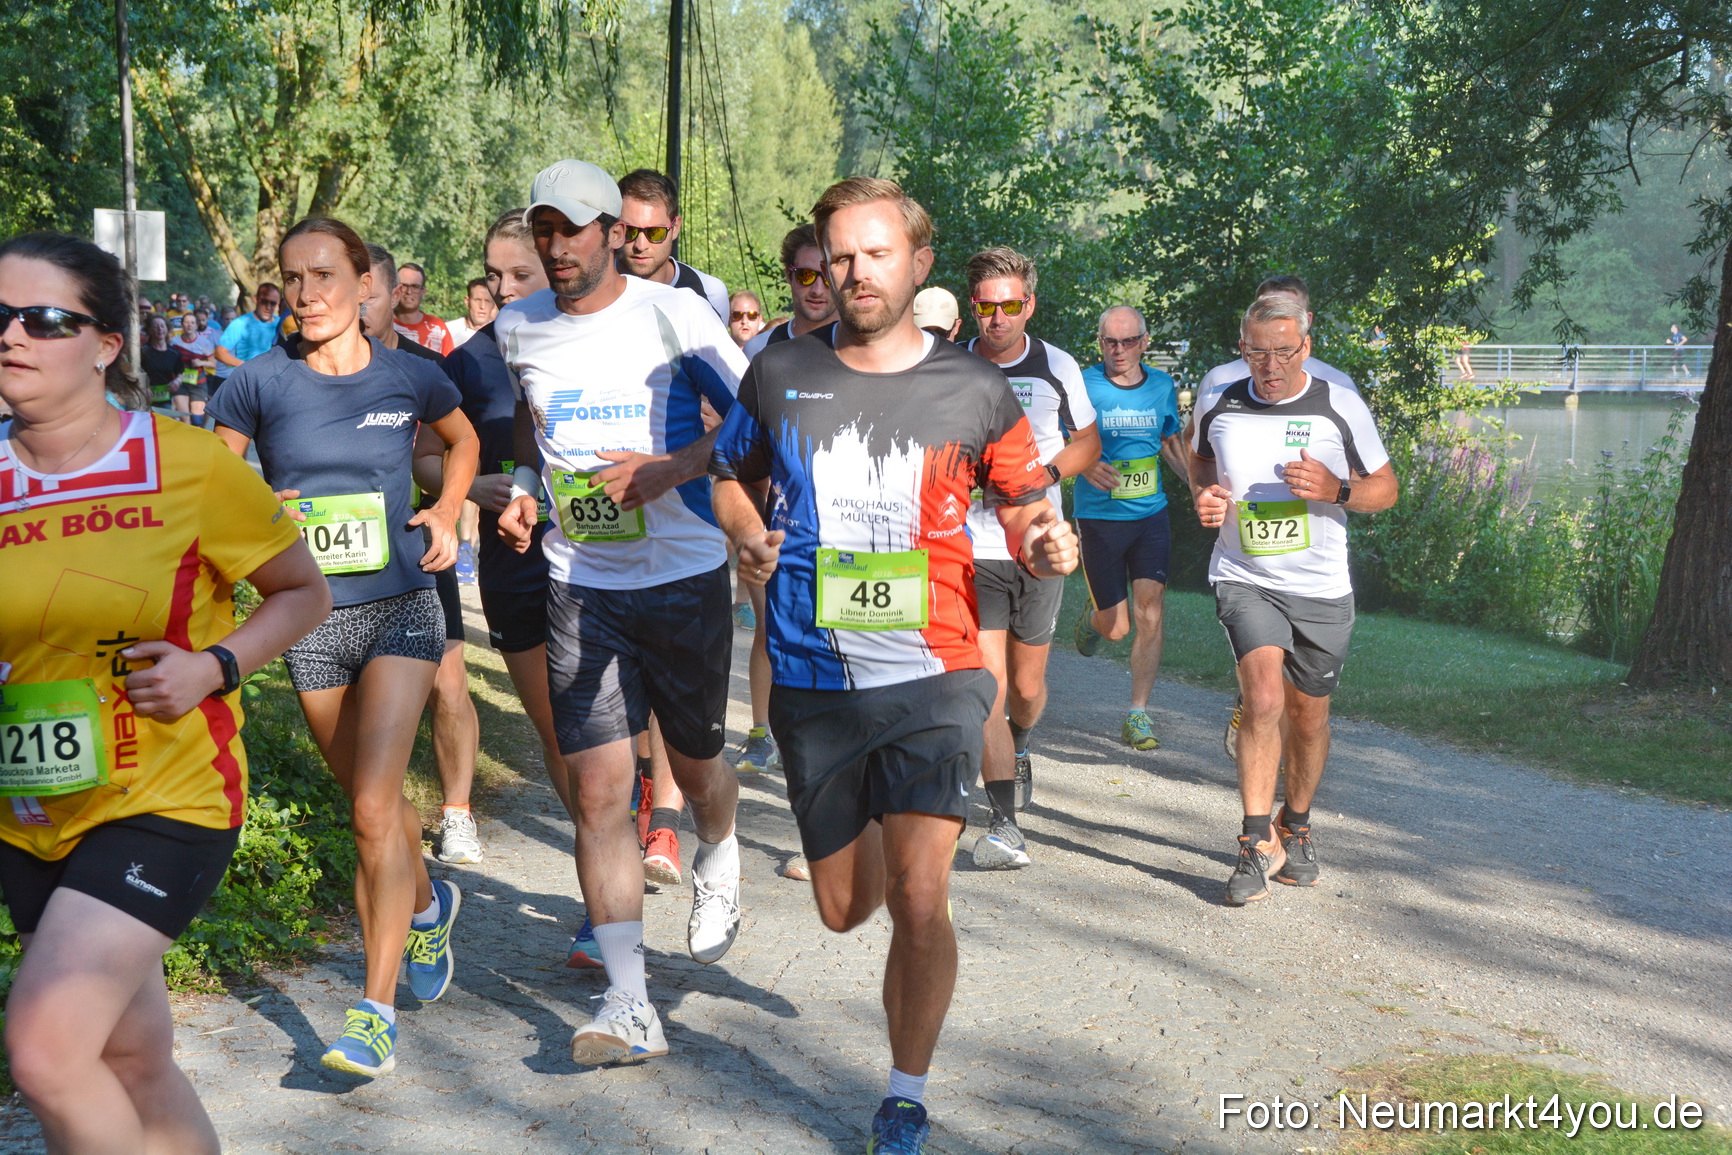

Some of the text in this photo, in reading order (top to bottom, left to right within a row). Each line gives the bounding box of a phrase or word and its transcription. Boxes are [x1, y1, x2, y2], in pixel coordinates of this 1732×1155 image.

[1102, 416, 1157, 428] NEUMARKT
[1123, 471, 1149, 488] 790
[570, 497, 620, 522] 633
[832, 498, 900, 512] AUTOHAUS
[62, 504, 164, 538] BÖGL
[841, 509, 889, 524] MÜLLER
[1245, 519, 1299, 540] 1372
[850, 581, 892, 609] 48
[839, 616, 865, 624] Autohaus
[840, 608, 904, 618] Libner Dominik
[36, 763, 80, 775] Marketa
[57, 773, 82, 783] GmbH
